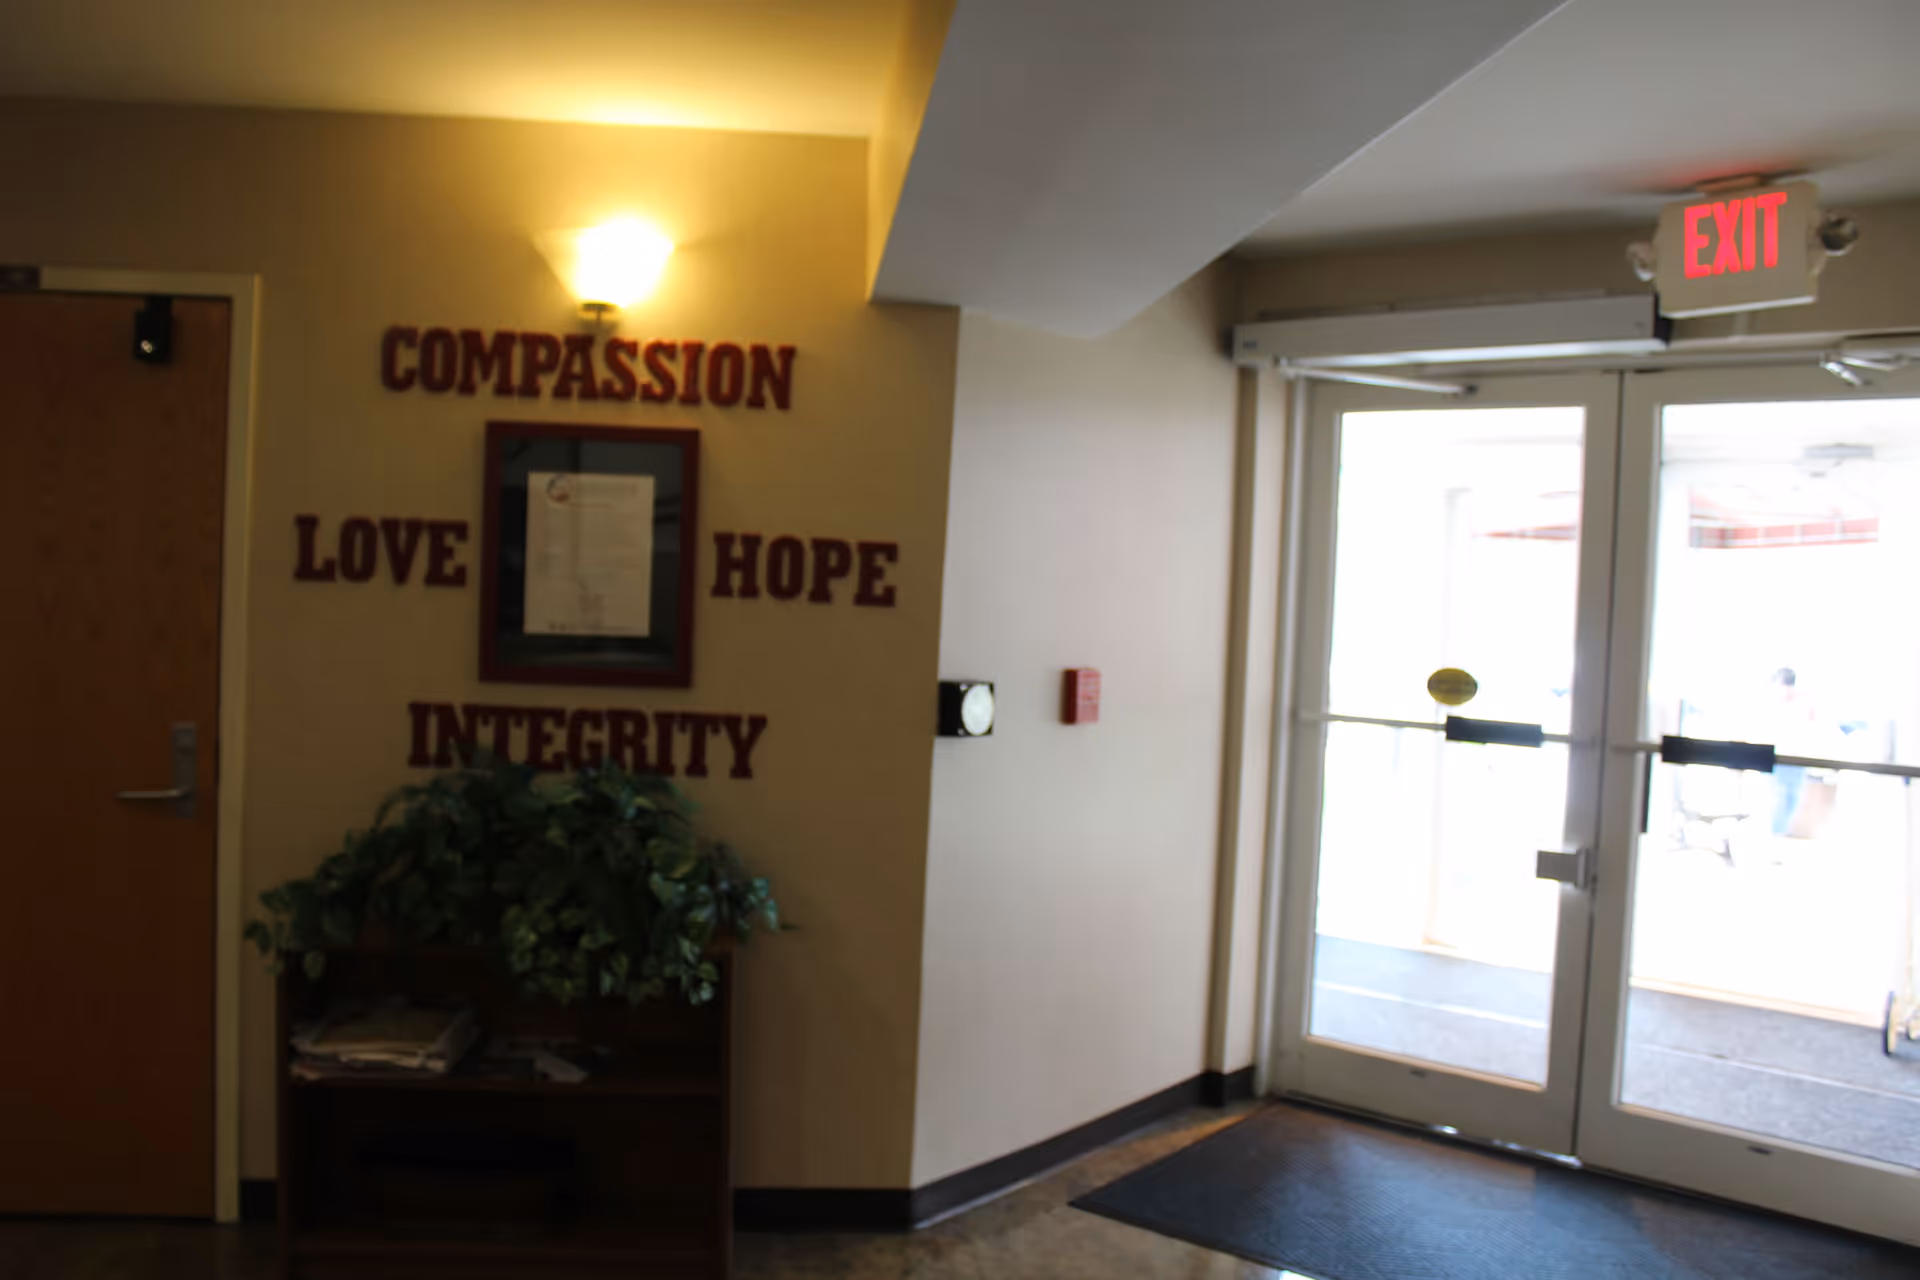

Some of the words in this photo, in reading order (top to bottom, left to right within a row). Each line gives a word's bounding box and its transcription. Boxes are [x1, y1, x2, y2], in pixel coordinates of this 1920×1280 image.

[1684, 191, 1788, 279] EXIT
[381, 325, 797, 411] COMPASSION
[294, 514, 468, 587] LOVE
[711, 532, 899, 607] HOPE
[408, 701, 768, 779] INTEGRITY
